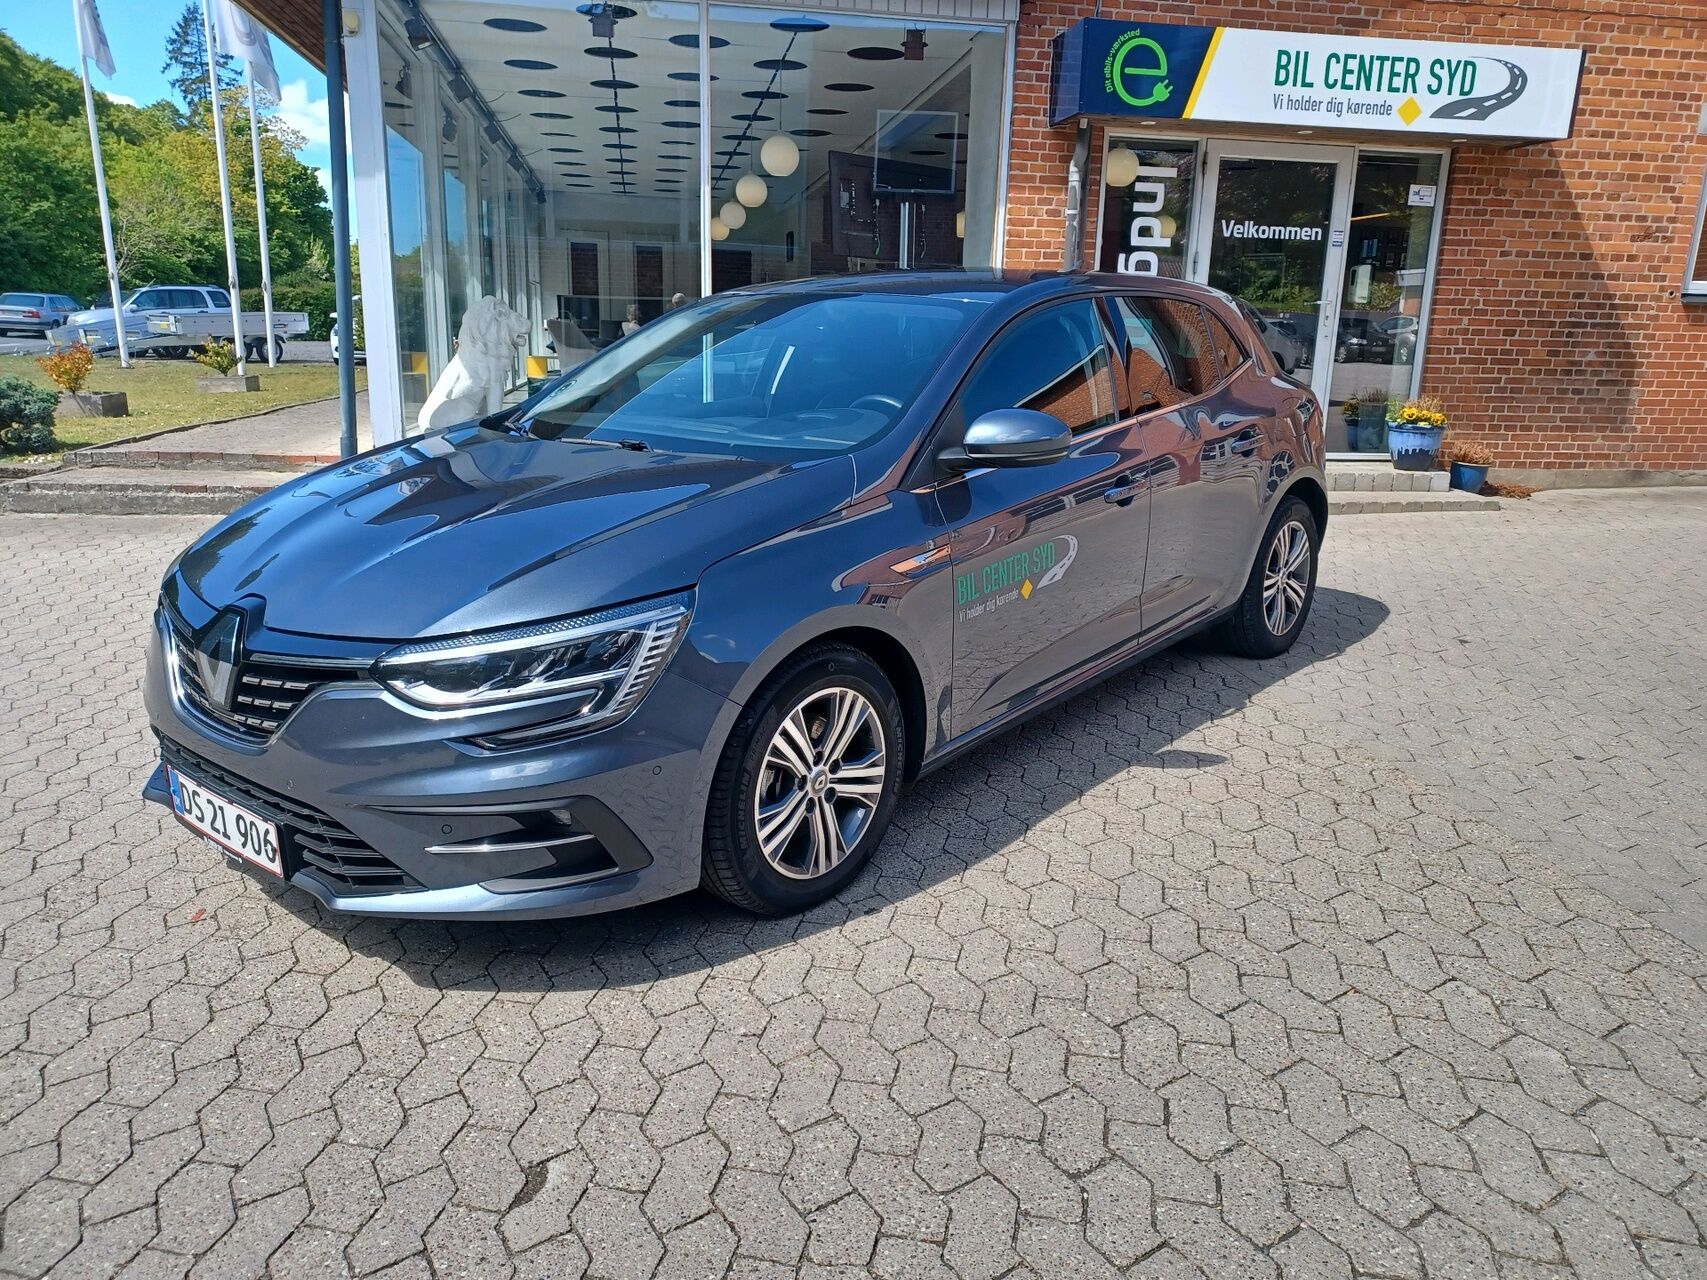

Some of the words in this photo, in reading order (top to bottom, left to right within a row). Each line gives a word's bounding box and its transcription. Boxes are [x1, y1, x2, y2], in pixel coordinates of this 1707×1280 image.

[1104, 79, 1114, 93] Dit
[1274, 49, 1315, 88] BIL
[1323, 52, 1420, 94] CENTER
[1427, 58, 1477, 97] SYD
[1273, 93, 1284, 110] Vi
[1286, 95, 1323, 112] holder
[1326, 99, 1343, 118] dig
[1346, 98, 1393, 116] kørende
[1221, 219, 1322, 241] Velkommen
[957, 573, 980, 605] BIL
[983, 552, 1030, 593] CENTER
[1033, 542, 1056, 573] SYD
[959, 608, 967, 623] Vi
[966, 603, 985, 620] holder
[986, 597, 996, 612] dig
[996, 587, 1019, 607] kørende
[235, 813, 277, 864] 906
